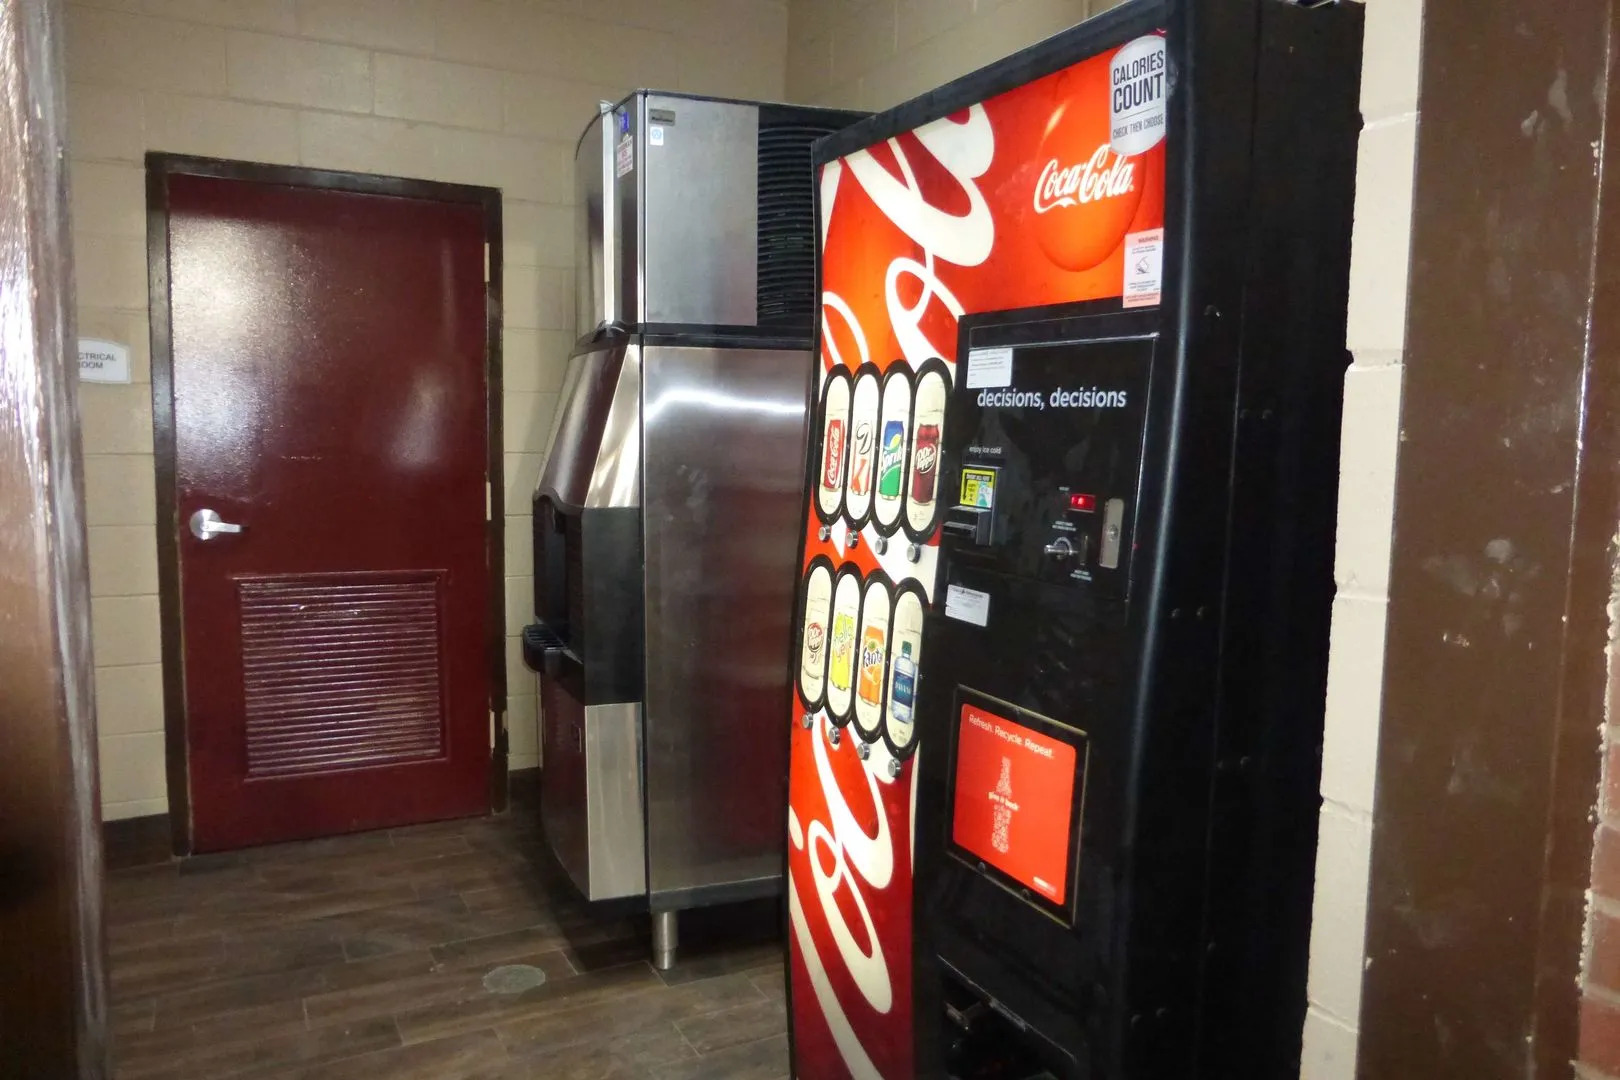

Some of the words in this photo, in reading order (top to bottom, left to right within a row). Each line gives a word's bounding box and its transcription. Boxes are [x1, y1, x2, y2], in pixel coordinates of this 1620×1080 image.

[1113, 50, 1164, 86] CALORIES
[1113, 72, 1164, 114] COUNT
[1112, 126, 1129, 140] CHECK
[1130, 119, 1143, 134] THEN
[1143, 113, 1164, 130] CHOOSE
[1034, 143, 1135, 214] Coca-Cola
[977, 388, 1046, 411] decisions,
[1049, 386, 1128, 408] decisions
[969, 714, 994, 733] Refresh.
[994, 725, 1023, 745] Recycle.
[1024, 738, 1054, 759] Repeat.
